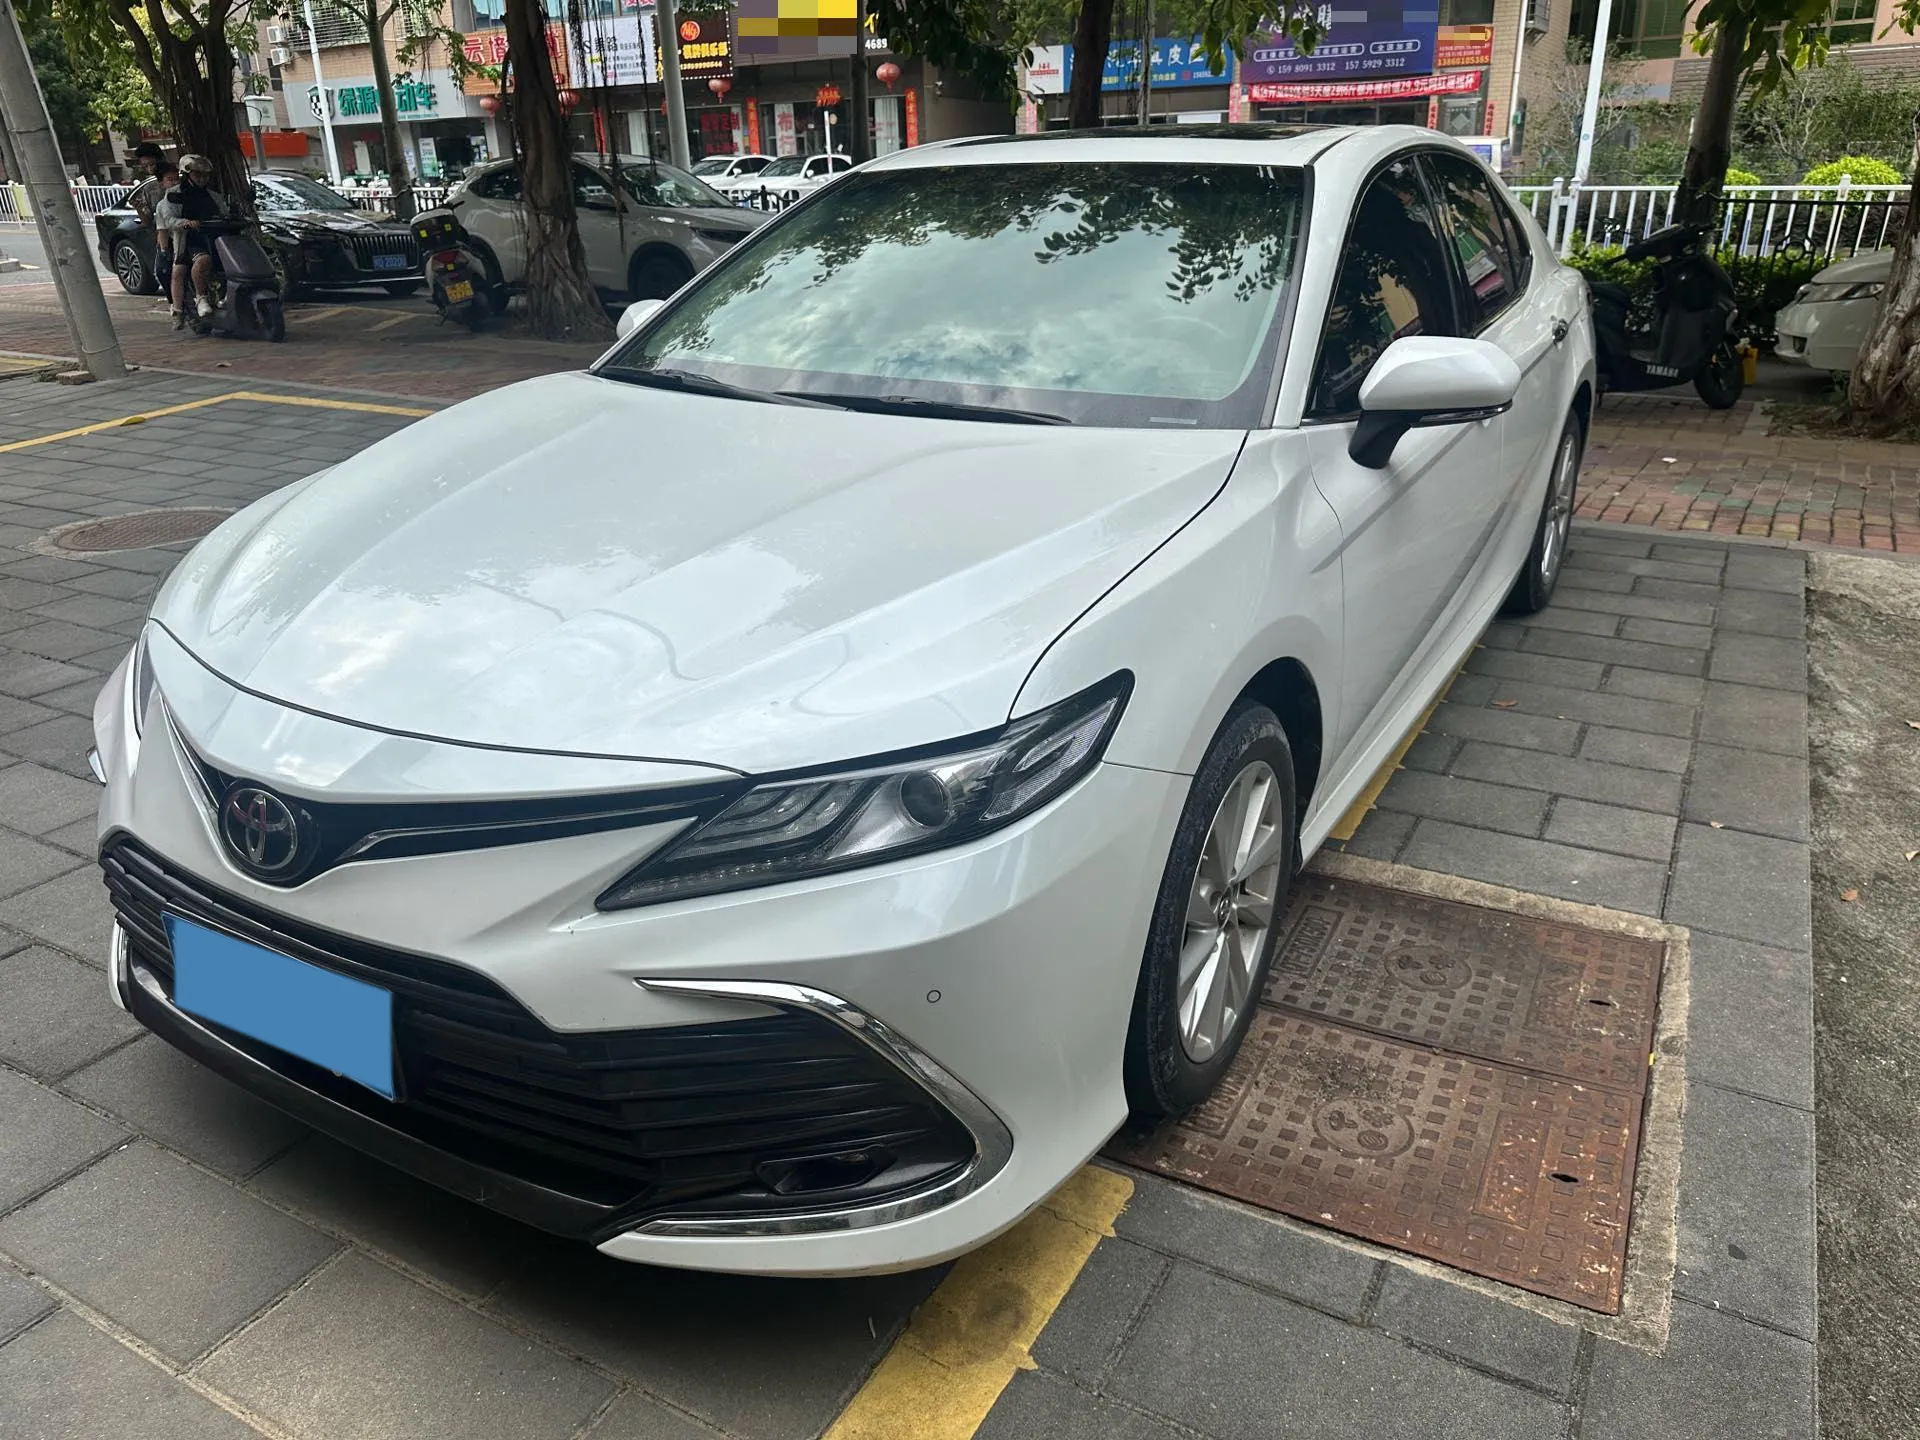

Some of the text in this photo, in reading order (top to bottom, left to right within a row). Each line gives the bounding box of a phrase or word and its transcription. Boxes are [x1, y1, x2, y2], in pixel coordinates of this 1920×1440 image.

[1278, 62, 1336, 74] 159 8091 3312
[1345, 58, 1405, 70] 157 5929 3312
[338, 82, 438, 116] 绿源动车
[1646, 364, 1680, 378] YAMAHA
